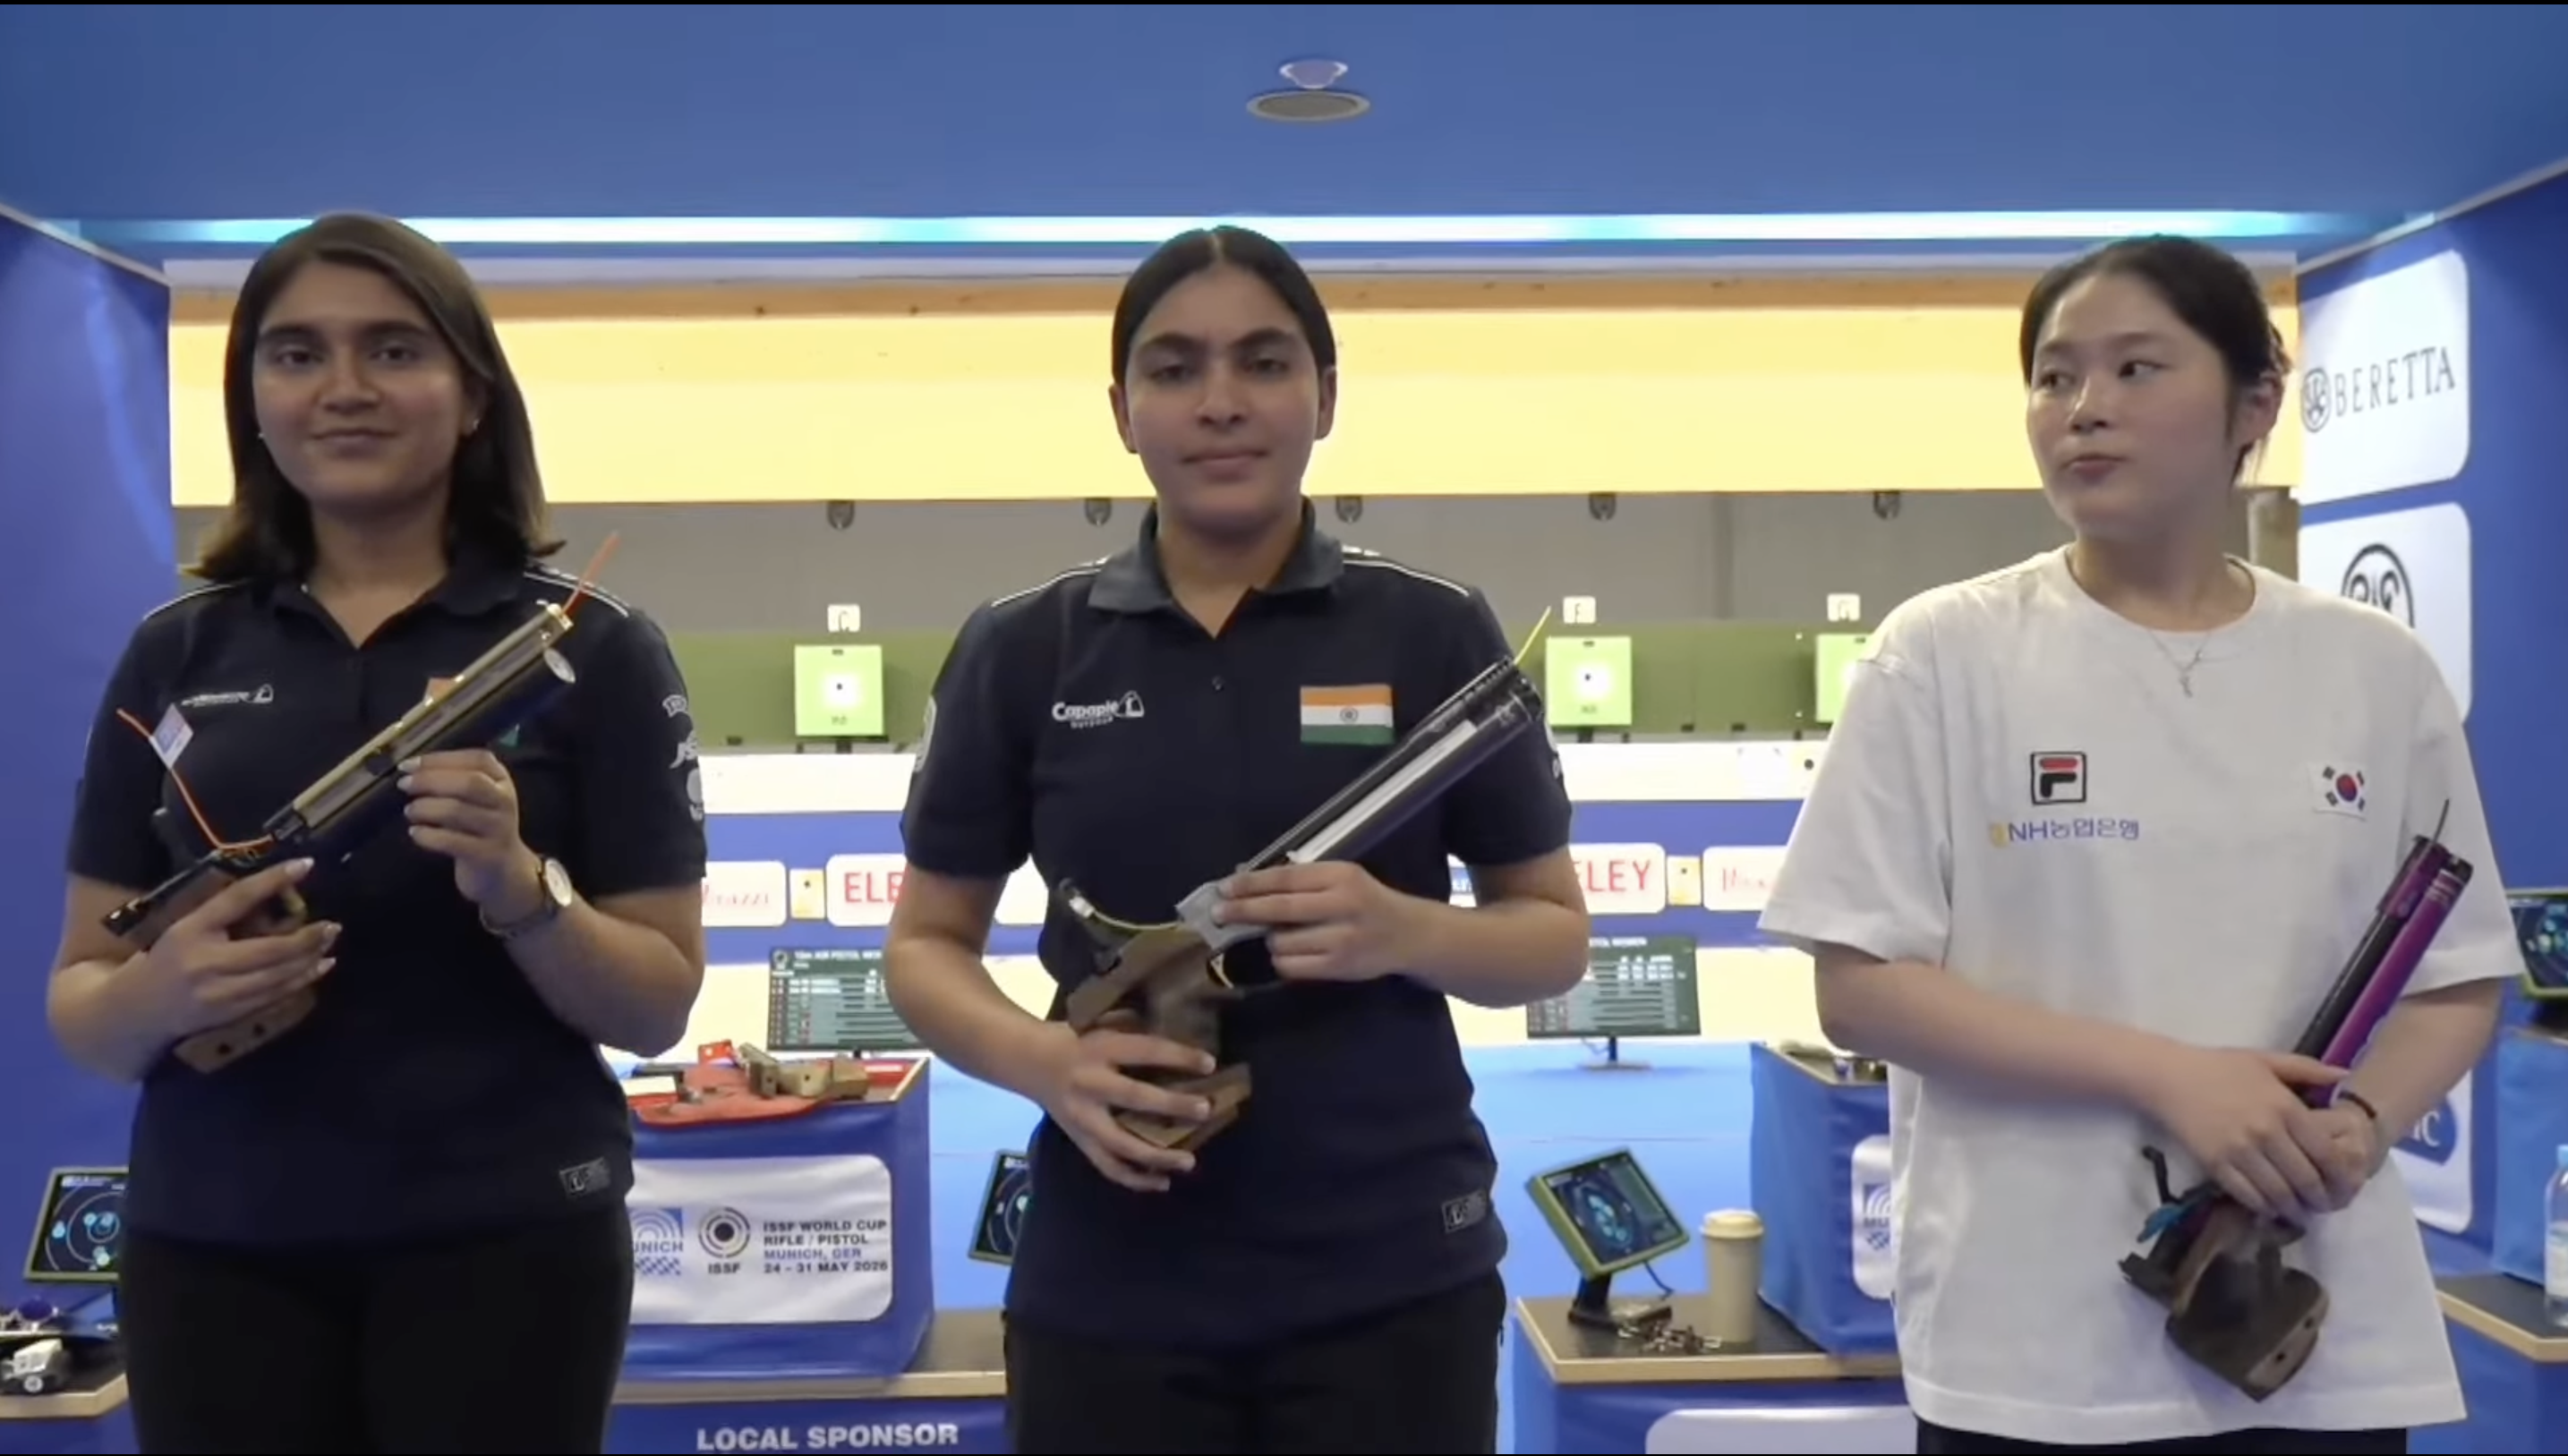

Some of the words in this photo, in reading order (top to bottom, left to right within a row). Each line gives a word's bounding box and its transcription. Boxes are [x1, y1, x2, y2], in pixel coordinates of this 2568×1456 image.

[2334, 346, 2455, 417] BERETTA
[764, 1222, 795, 1232] ISSF
[798, 1221, 851, 1232] WORLD
[856, 1220, 887, 1230] CUP
[764, 1235, 804, 1246] RIFLE
[818, 1234, 869, 1245] PISTOL
[832, 1247, 862, 1259] GER
[708, 1263, 740, 1274] ISSF
[764, 1263, 781, 1273] 24
[818, 1262, 850, 1273] MAY
[854, 1260, 888, 1272] 2026
[696, 1426, 798, 1452] LOCAL
[807, 1423, 959, 1449] SPONSOR
